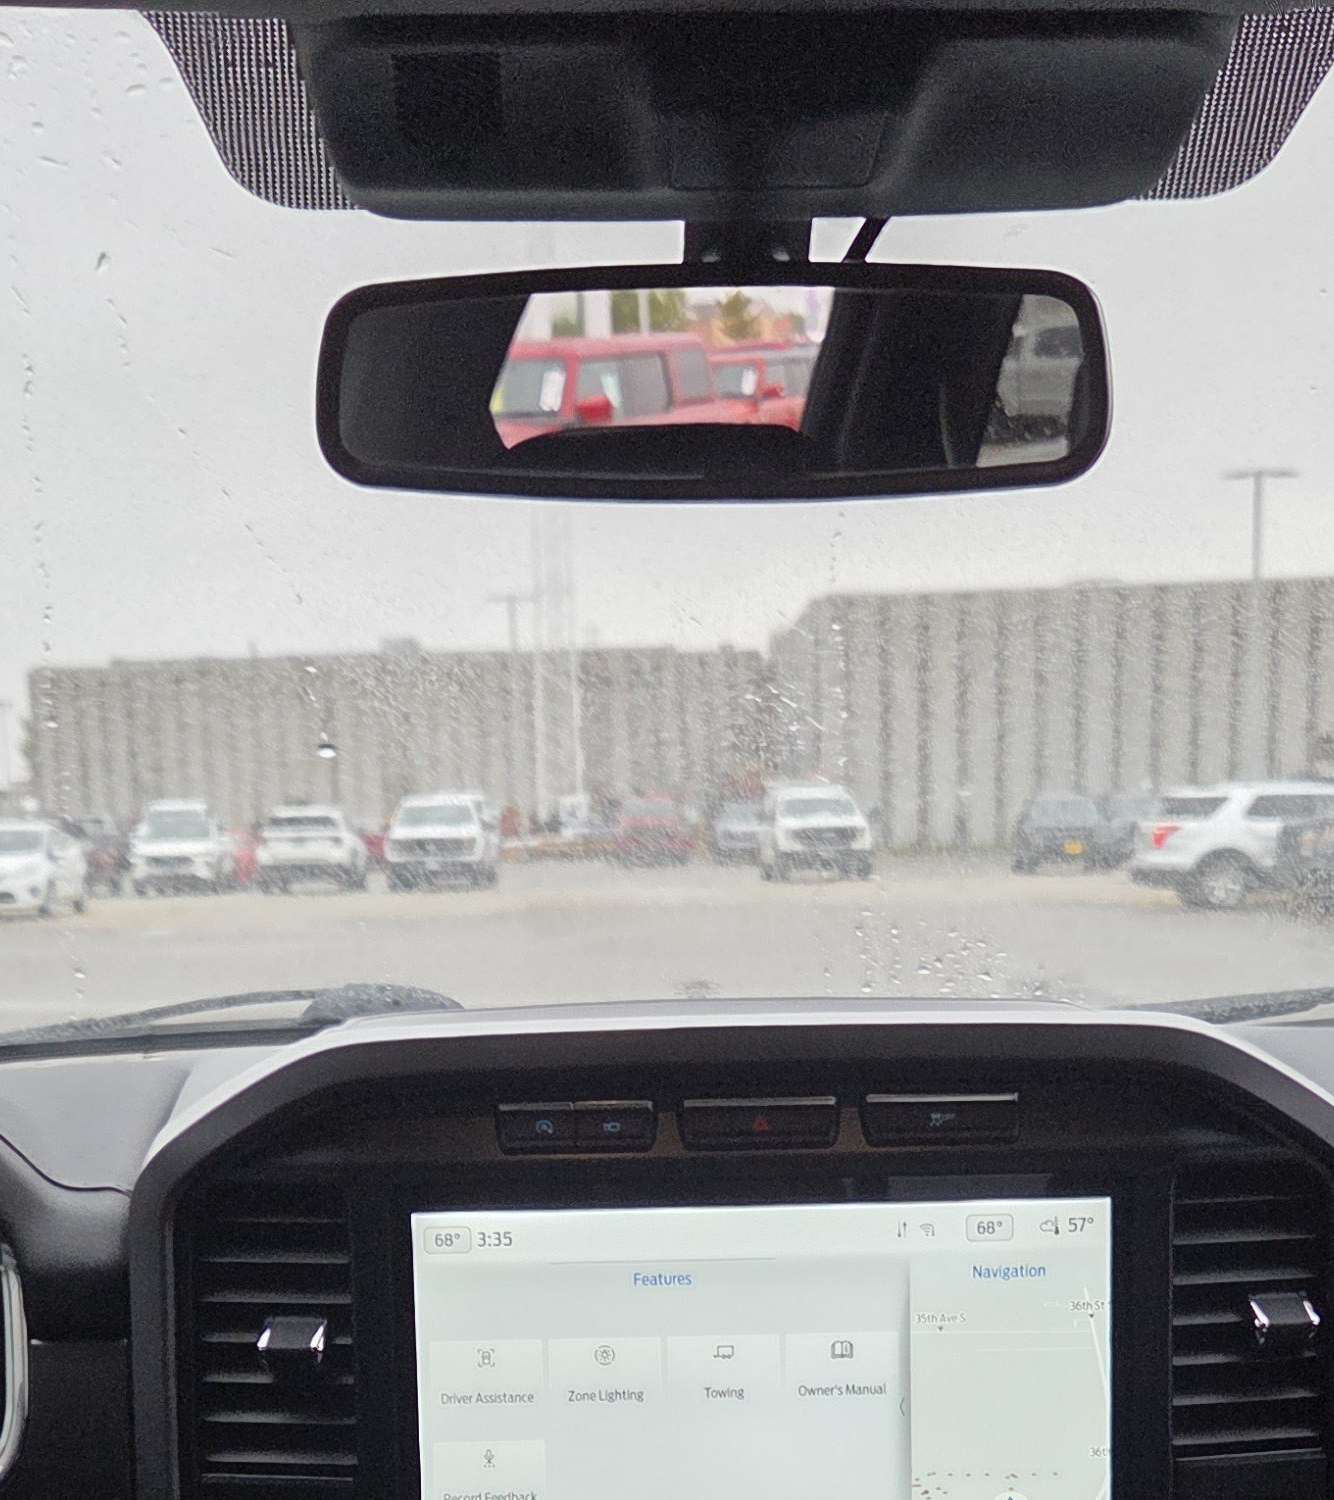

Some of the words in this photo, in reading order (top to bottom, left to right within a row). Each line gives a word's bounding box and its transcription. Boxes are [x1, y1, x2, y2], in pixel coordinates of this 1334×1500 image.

[977, 1220, 1003, 1235] 68°
[434, 1233, 461, 1247] 68°
[477, 1231, 513, 1247] 3:35
[633, 1272, 693, 1287] Features
[972, 1264, 1047, 1280] Navigation
[568, 1389, 597, 1402] Zone
[598, 1388, 644, 1403] Lighting
[704, 1386, 745, 1400] Towing
[798, 1384, 844, 1396] Owner's
[845, 1382, 887, 1396] Manual
[441, 1392, 473, 1405] Driver
[475, 1391, 535, 1405] Assistance
